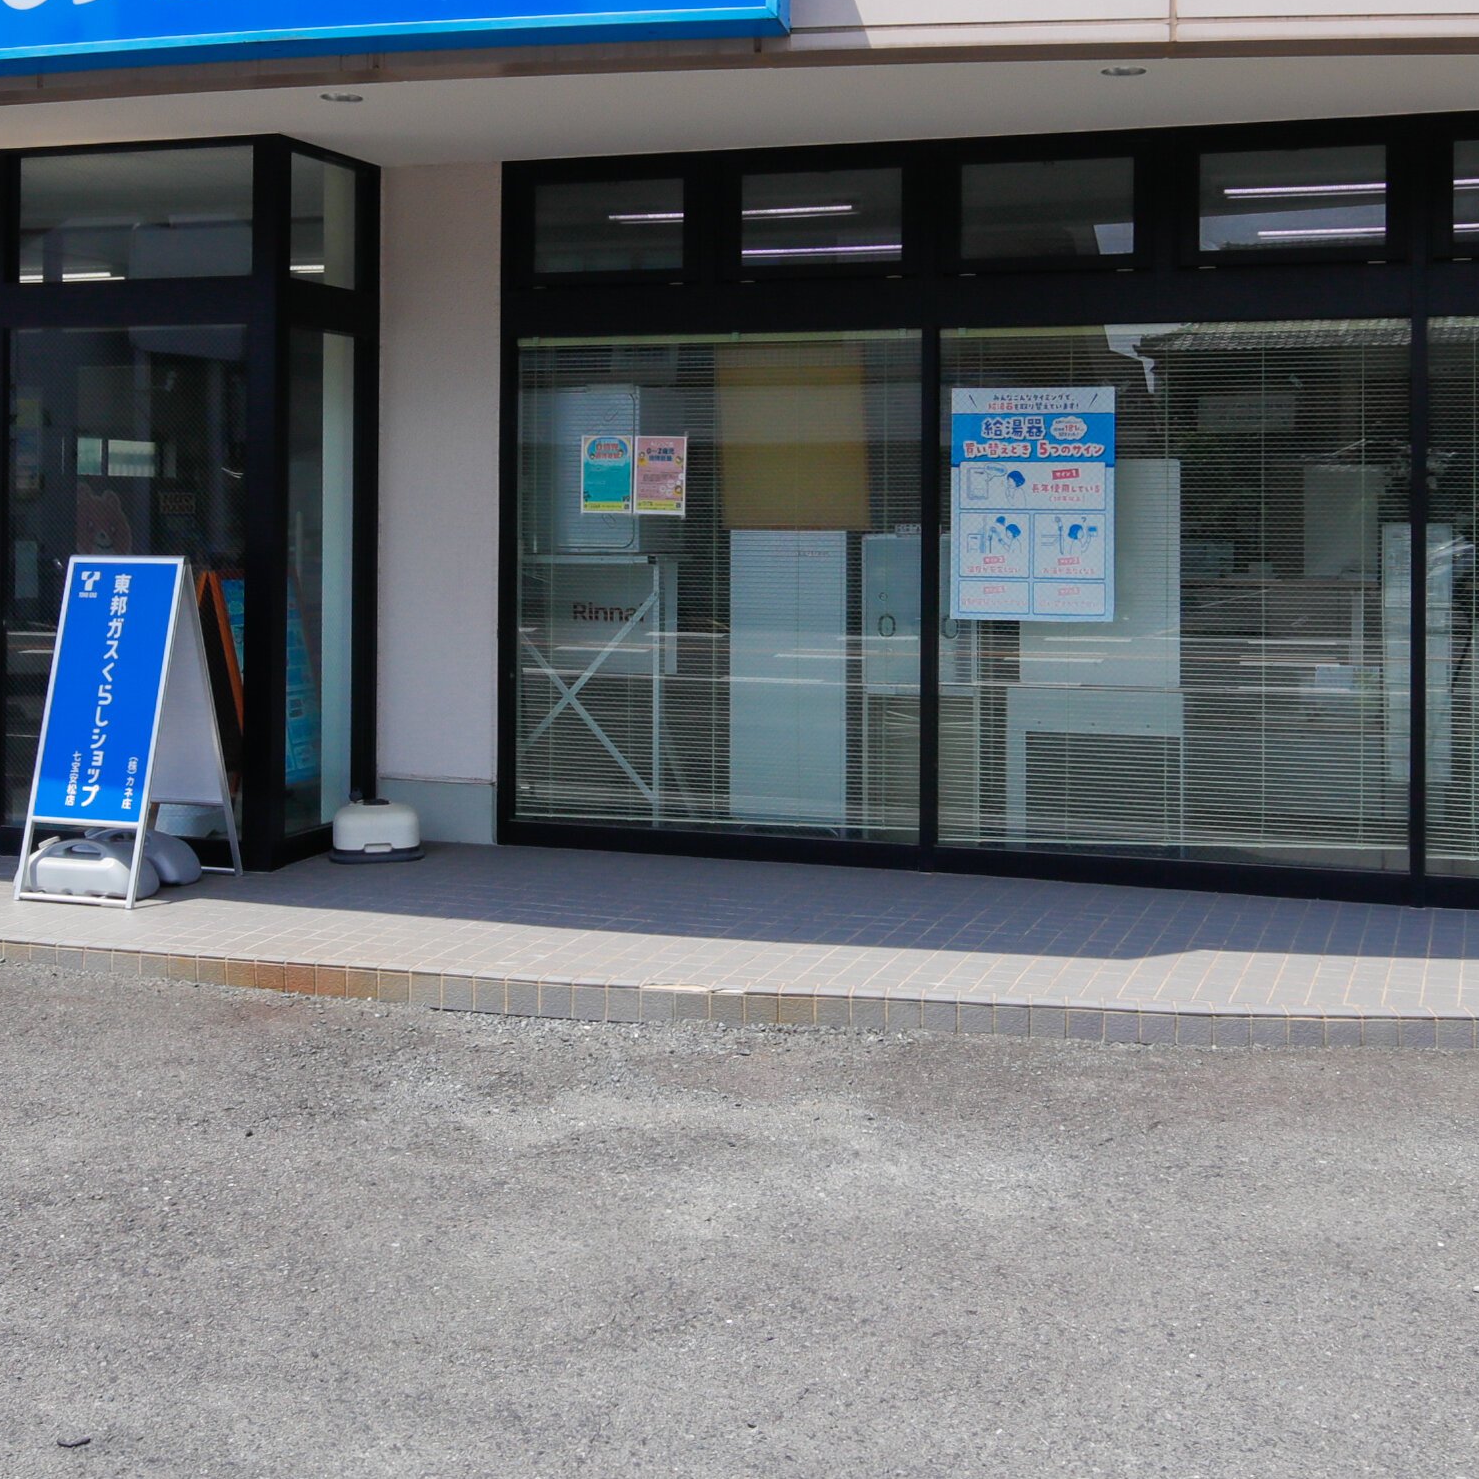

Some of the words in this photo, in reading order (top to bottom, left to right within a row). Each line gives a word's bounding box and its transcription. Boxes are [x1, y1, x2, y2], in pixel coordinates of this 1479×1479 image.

[982, 418, 1044, 438] 給湯器
[965, 442, 1032, 457] 買い替えどき
[1038, 441, 1104, 457] 5つのサイン
[81, 573, 132, 808] 東邦ガスくらしショップ
